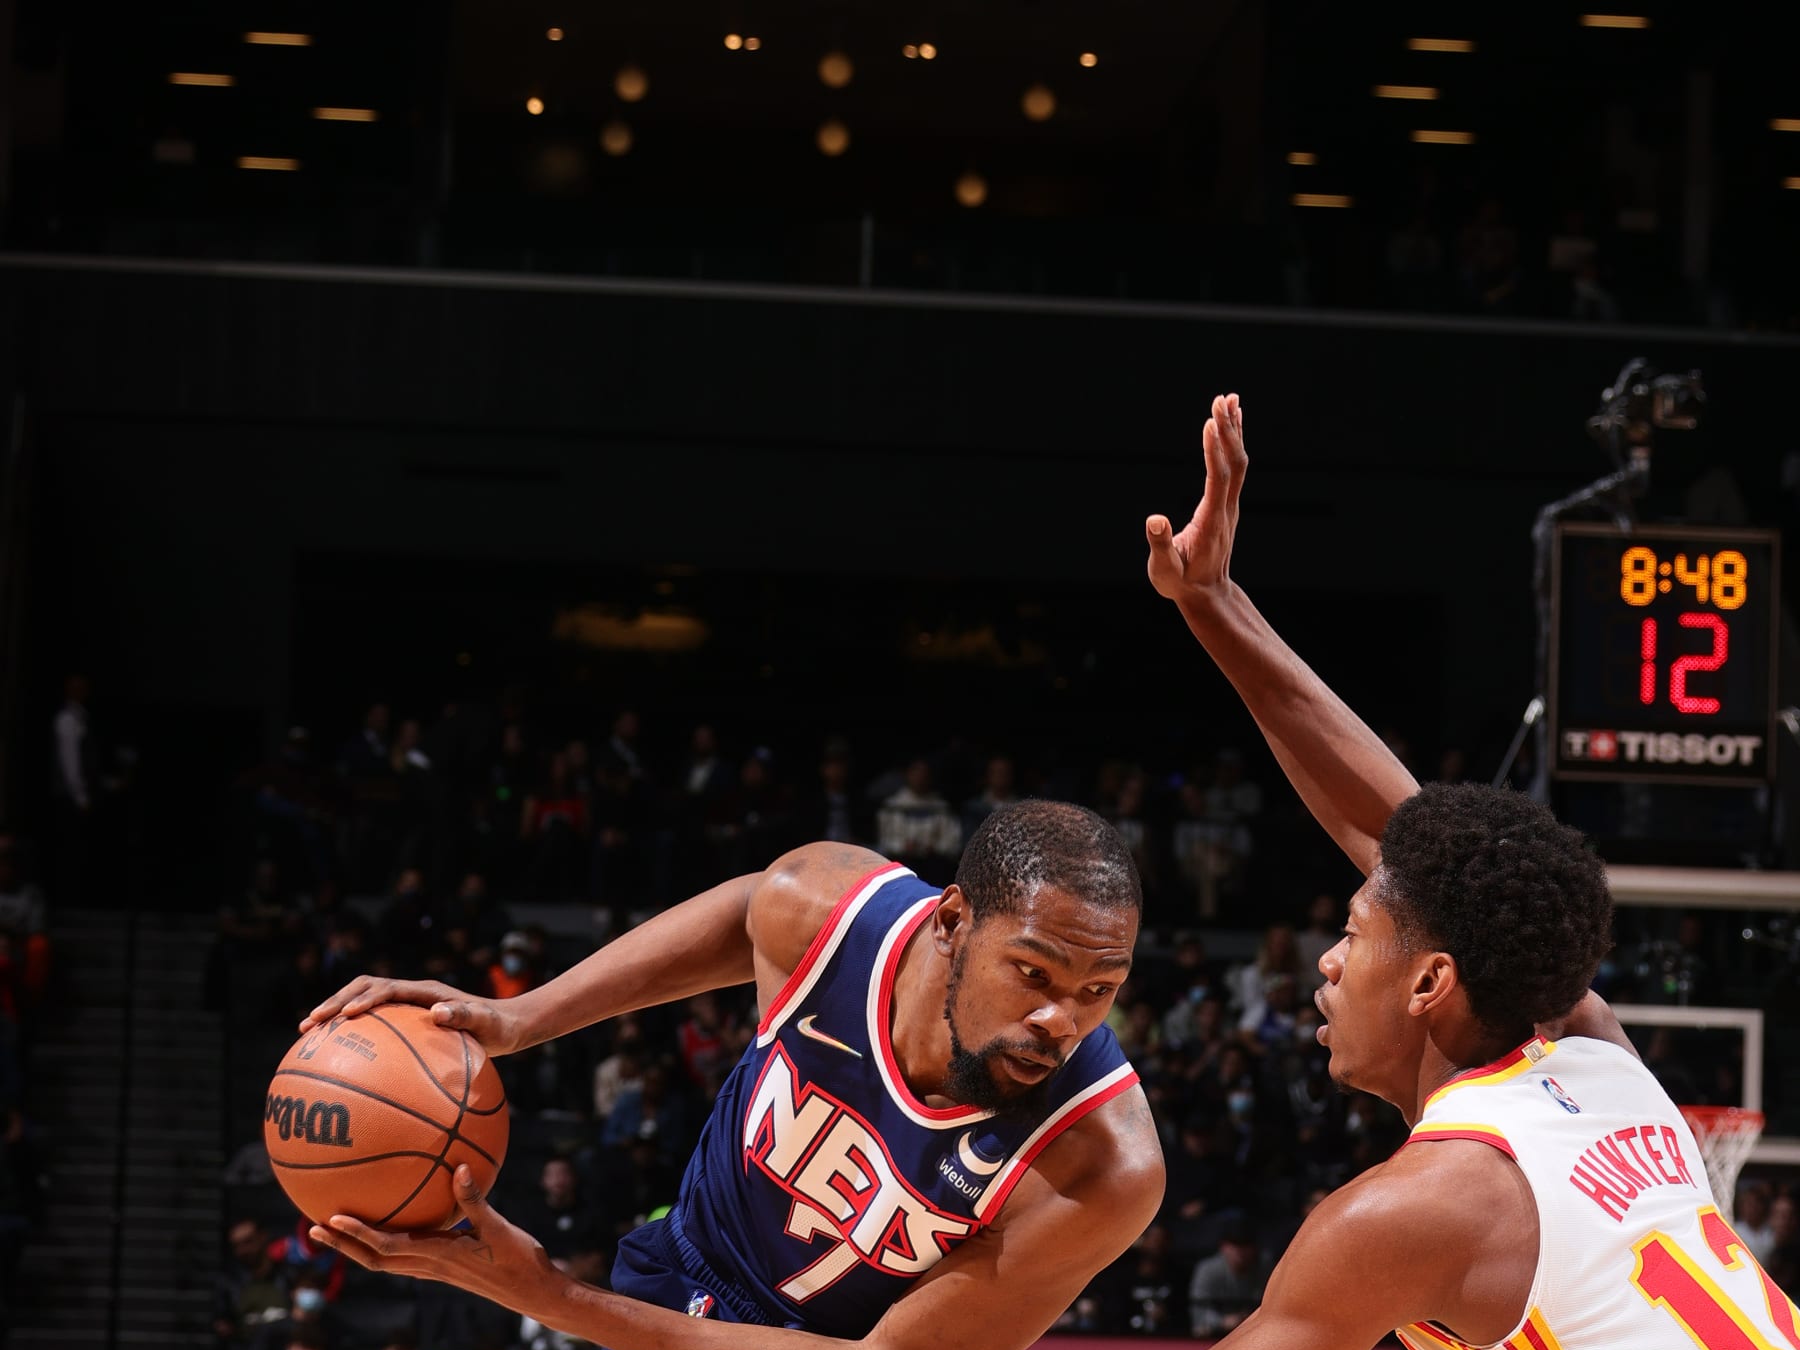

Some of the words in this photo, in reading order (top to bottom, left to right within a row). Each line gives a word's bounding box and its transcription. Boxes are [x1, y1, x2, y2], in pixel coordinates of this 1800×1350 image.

[1621, 546, 1747, 610] 8:48
[1640, 612, 1728, 714] 12
[1620, 731, 1761, 766] TISSOT
[264, 1092, 353, 1148] Wilso
[744, 1040, 982, 1277] NETS
[939, 1158, 982, 1199] Webull
[1569, 1124, 1697, 1223] HUNTER
[775, 1198, 862, 1305] 7
